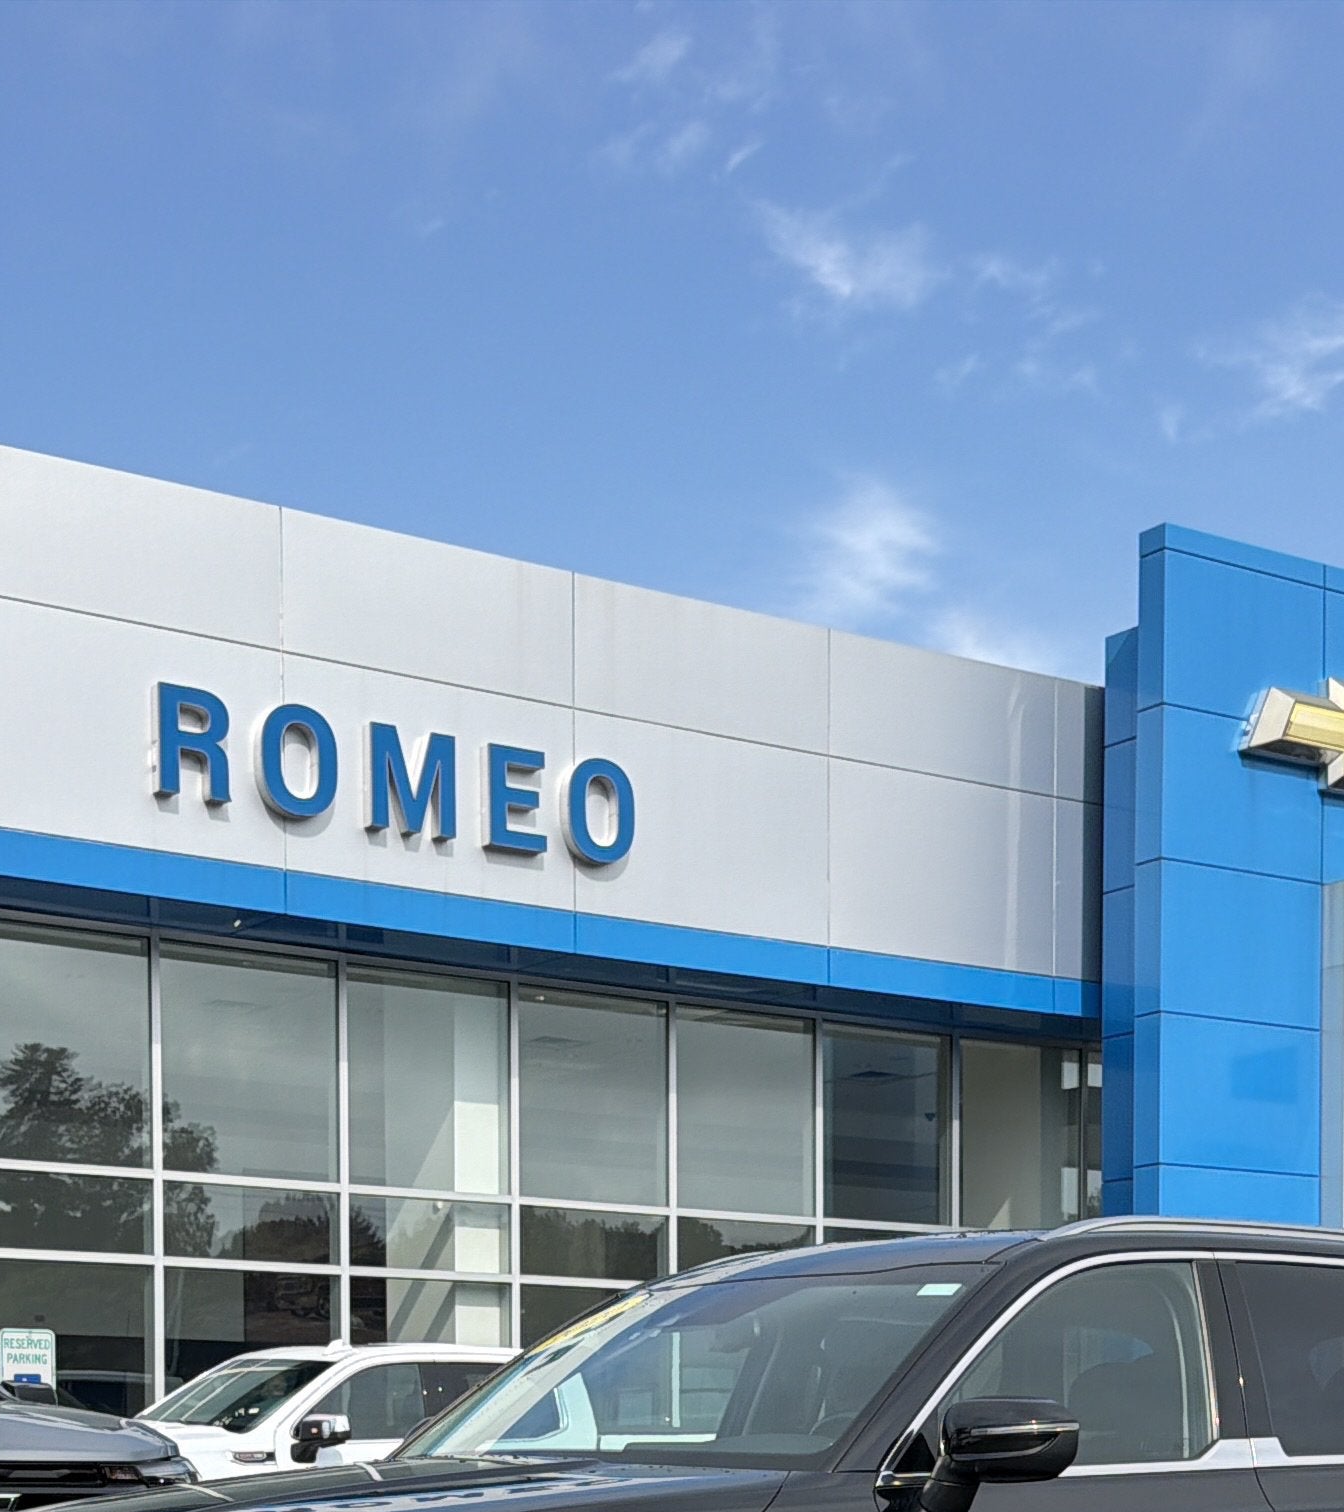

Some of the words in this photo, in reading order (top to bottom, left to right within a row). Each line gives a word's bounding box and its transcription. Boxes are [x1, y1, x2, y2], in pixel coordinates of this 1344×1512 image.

[153, 680, 636, 865] ROMEO
[3, 1337, 51, 1350] RESERVED
[6, 1352, 48, 1365] PARKING
